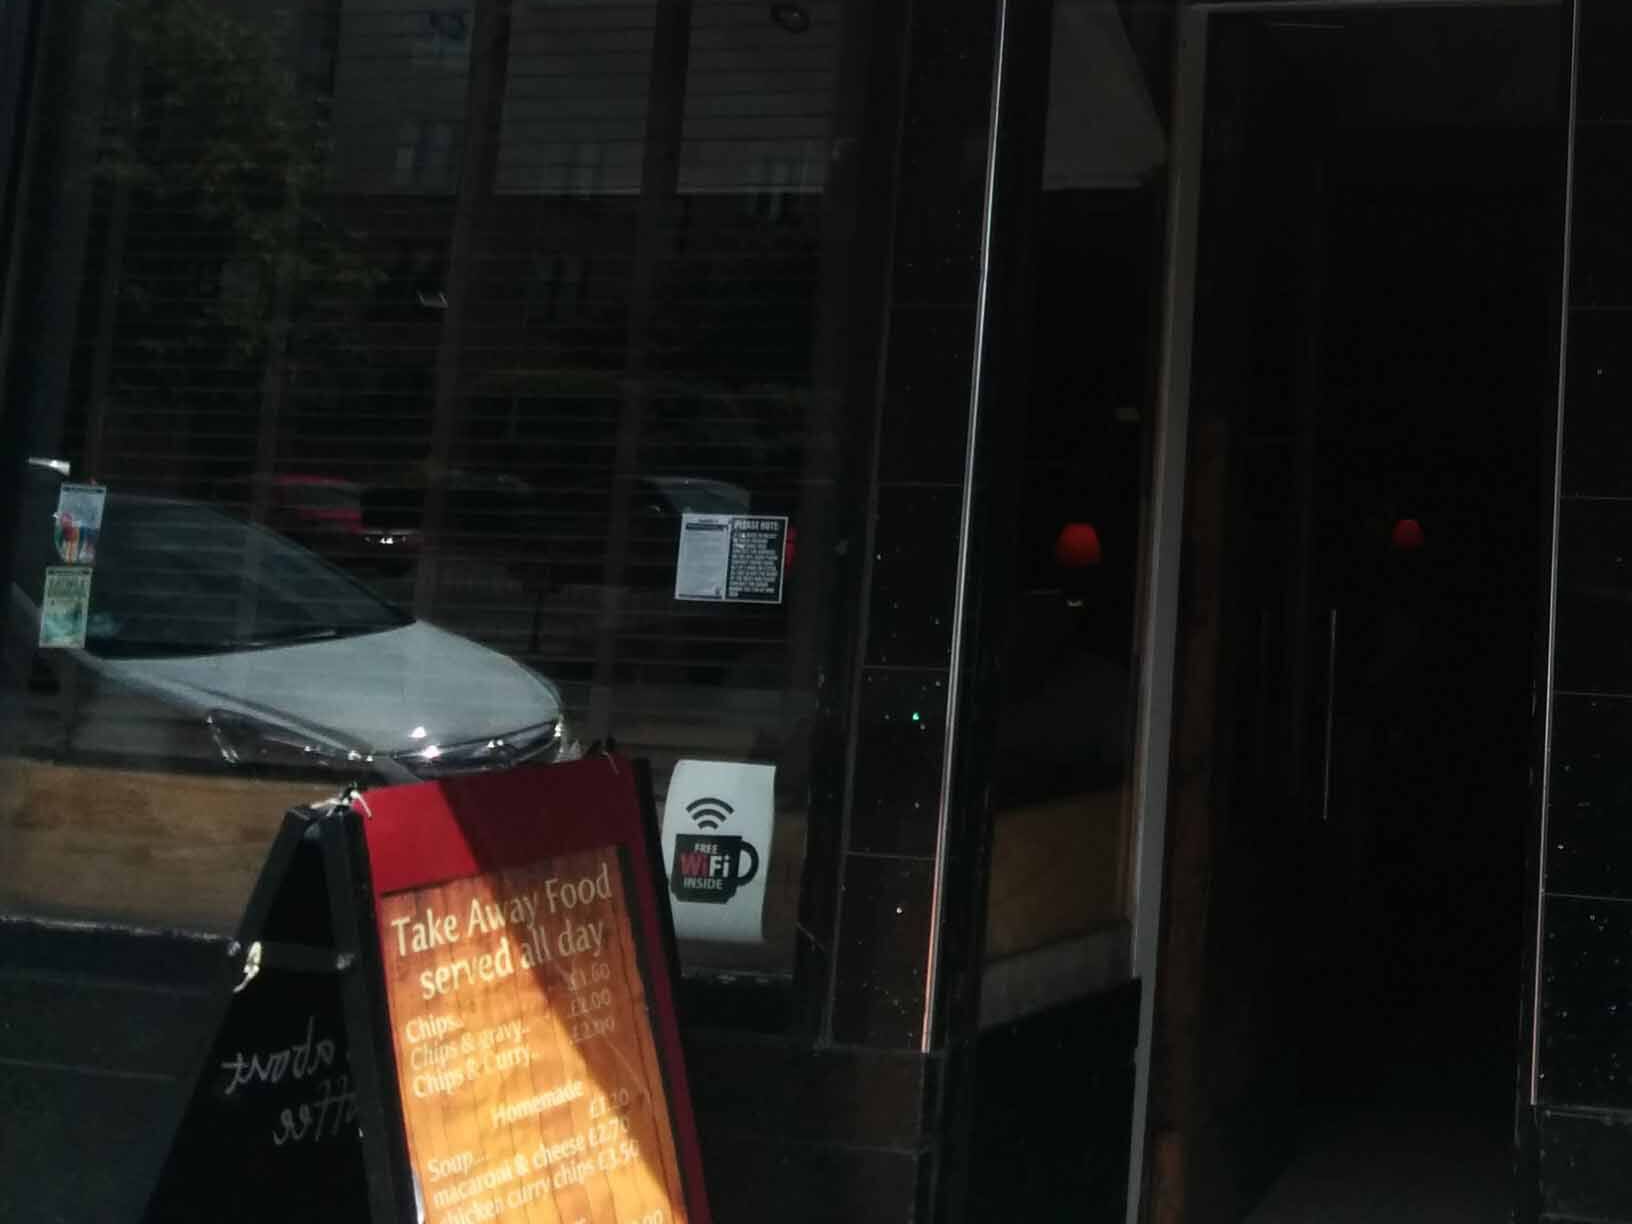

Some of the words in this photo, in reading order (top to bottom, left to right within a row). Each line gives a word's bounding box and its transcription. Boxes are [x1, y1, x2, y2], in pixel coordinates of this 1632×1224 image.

[694, 843, 719, 854] FREE
[680, 852, 730, 878] WiFi
[683, 878, 724, 890] INSIDE
[391, 908, 460, 957] Take
[466, 891, 539, 936] Away
[545, 862, 613, 913] Food
[419, 937, 515, 1000] served
[520, 925, 553, 970] all
[557, 920, 605, 958] day
[532, 1133, 587, 1169] cheese
[553, 1160, 595, 1190] chips
